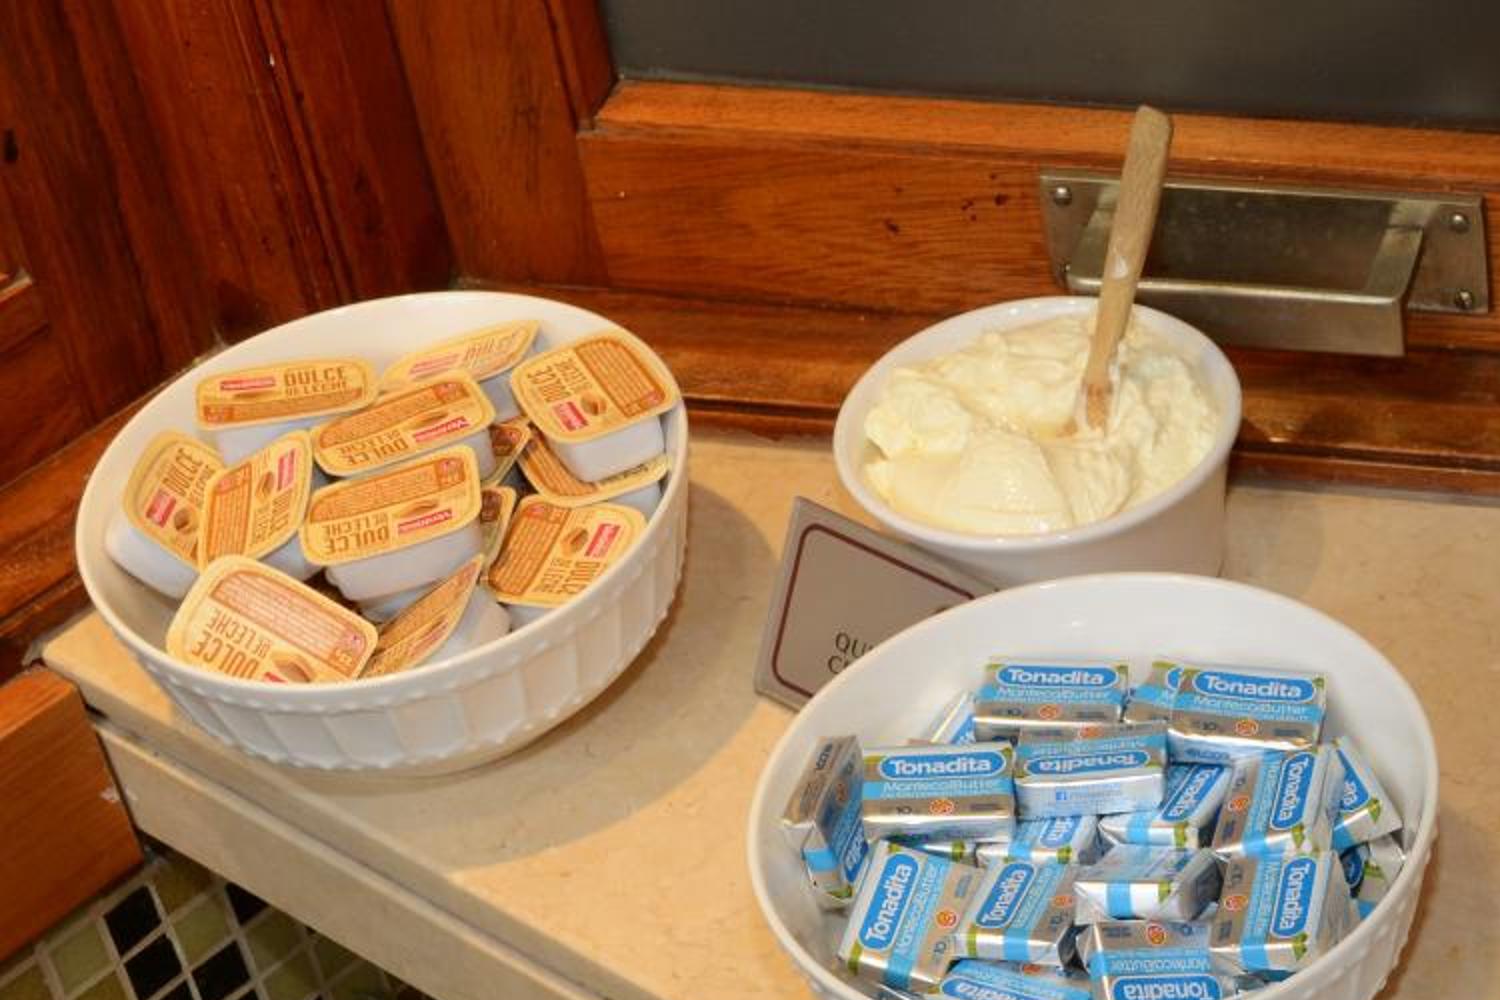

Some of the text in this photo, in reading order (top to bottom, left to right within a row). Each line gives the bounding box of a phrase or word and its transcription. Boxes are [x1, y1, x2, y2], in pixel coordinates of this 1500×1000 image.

[283, 366, 346, 387] DULCE
[347, 438, 409, 466] DULCE
[326, 525, 390, 555] DULCE
[206, 607, 258, 652] LECHE
[191, 630, 260, 679] DULCE
[835, 631, 875, 659] QU
[827, 654, 849, 675] C
[1007, 668, 1104, 685] Tonadita
[1203, 673, 1303, 699] Tonadita
[889, 756, 992, 775] Tonadita
[1038, 753, 1138, 773] Tonadita
[1278, 756, 1310, 822] Tonadita
[864, 863, 913, 942] Tonadita
[981, 868, 1028, 923] Tonadita
[1279, 862, 1311, 930] Tonadita
